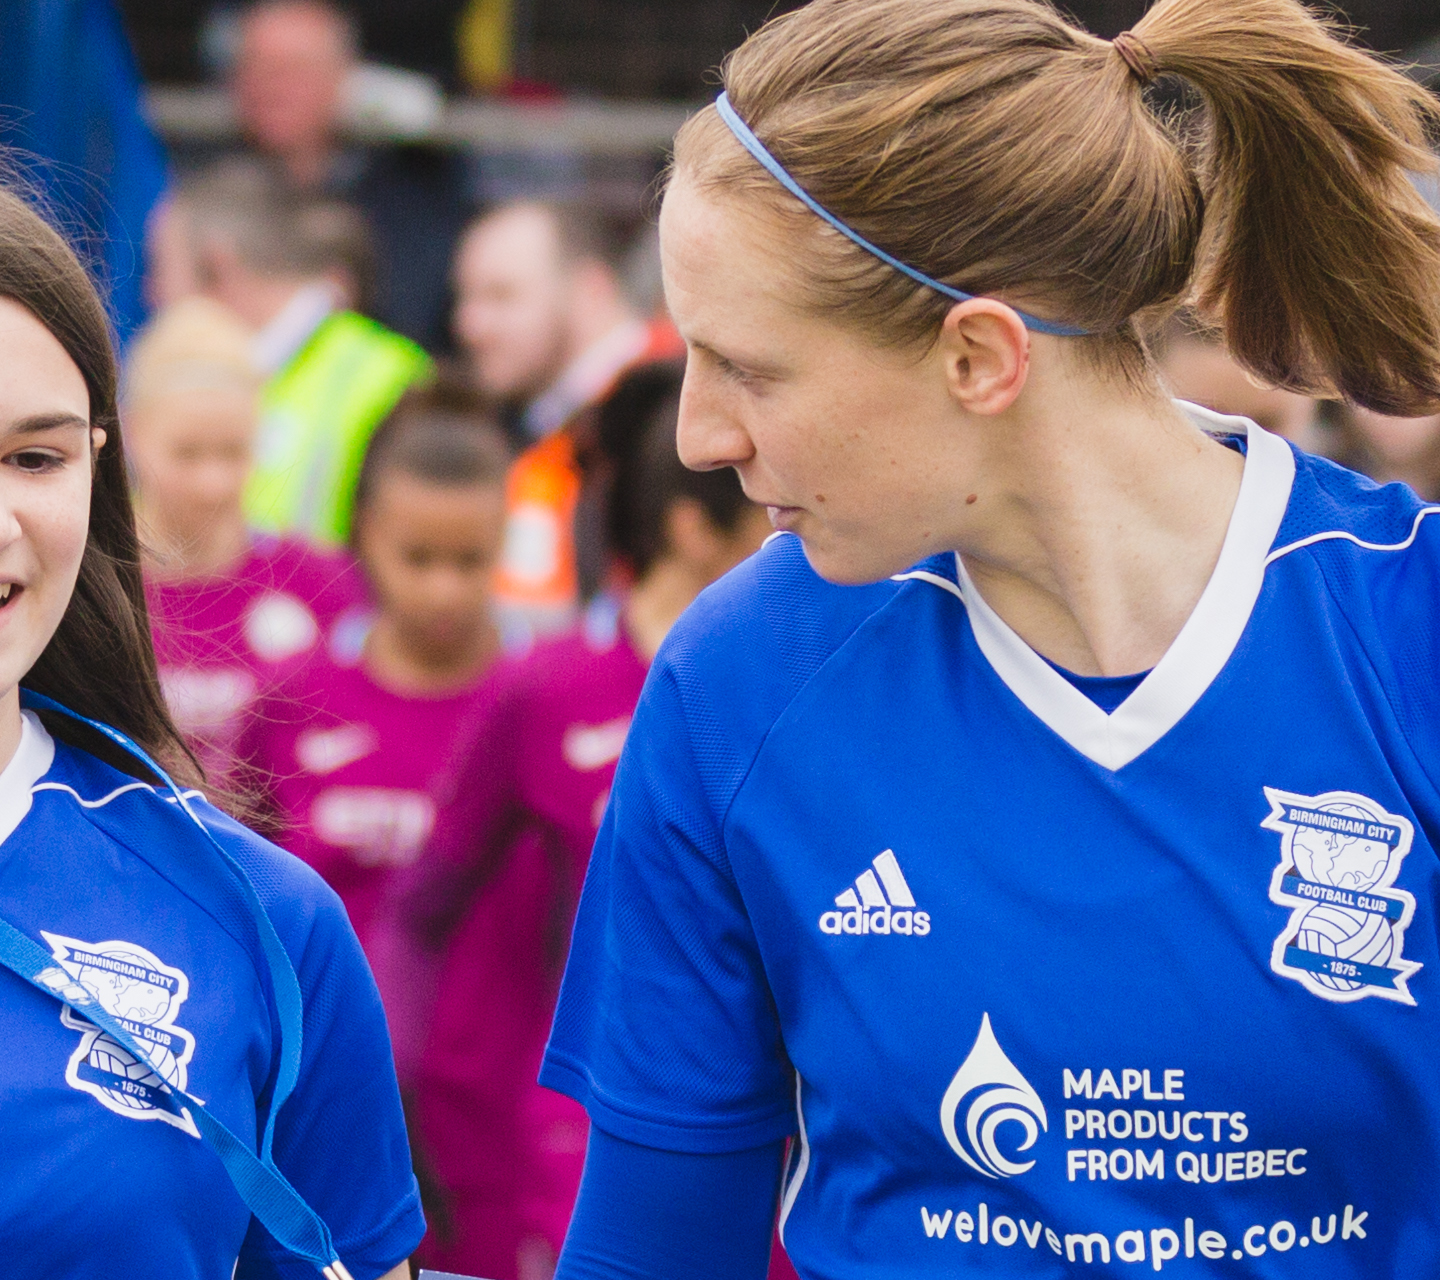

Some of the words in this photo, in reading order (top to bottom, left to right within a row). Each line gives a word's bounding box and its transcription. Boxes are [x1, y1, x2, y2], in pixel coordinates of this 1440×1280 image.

[1289, 808, 1365, 835] BIRMINGHAM
[1367, 824, 1395, 841] CITY
[1297, 882, 1355, 906] FOOTBALL
[1357, 895, 1388, 913] CLUB
[819, 905, 931, 936] adidas
[73, 951, 146, 979] BIRMINGHAM
[148, 972, 174, 988] CITY
[143, 1026, 172, 1045] CLUB
[1063, 1068, 1185, 1101] MAPLE
[1065, 1109, 1249, 1143] PRODUCTS
[1067, 1149, 1165, 1182] FROM
[1175, 1148, 1308, 1184] QUEBEC
[920, 1202, 1369, 1272] welovemaple.co.uk
